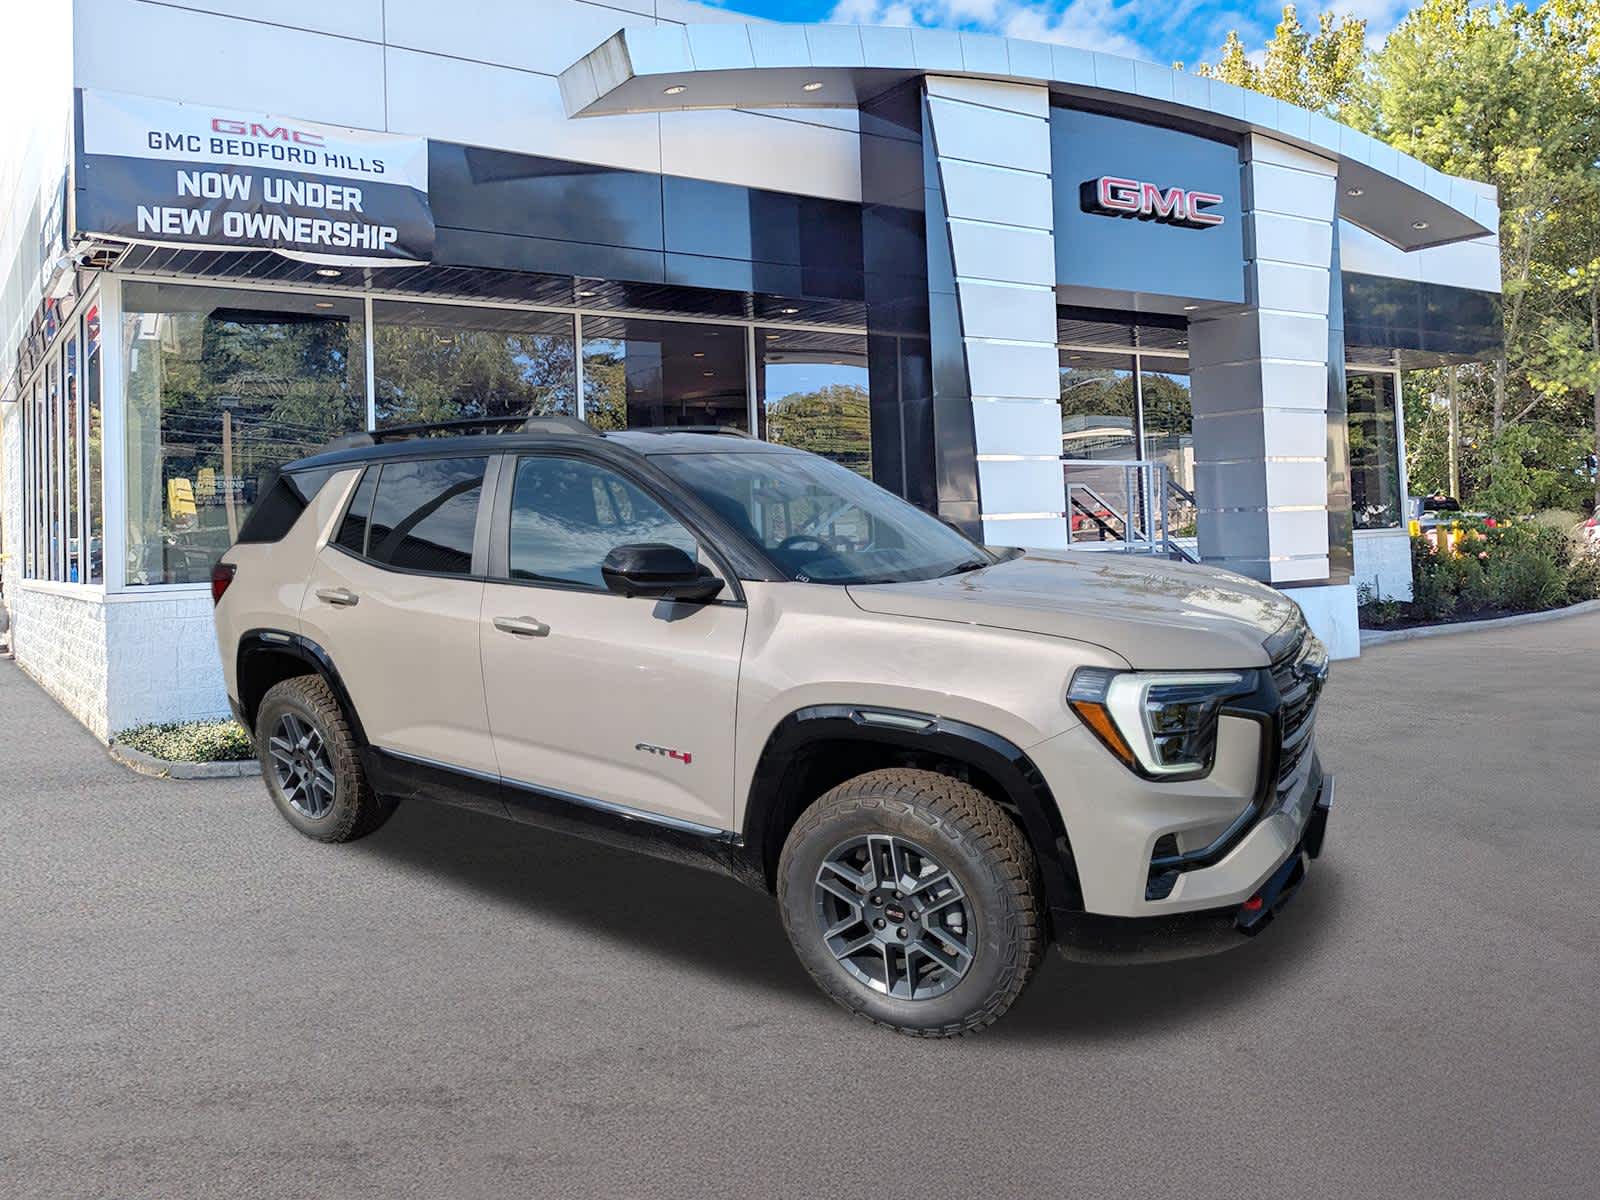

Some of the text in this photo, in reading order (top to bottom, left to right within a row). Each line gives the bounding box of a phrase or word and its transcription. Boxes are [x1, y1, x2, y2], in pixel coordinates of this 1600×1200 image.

[148, 131, 385, 174] GMC BEDFORD HILLS
[211, 118, 326, 148] GMC
[177, 170, 363, 212] NOW UNDER
[1097, 175, 1225, 226] GMC
[137, 205, 398, 250] NEW OWNERSHIP
[635, 743, 692, 764] AT4
